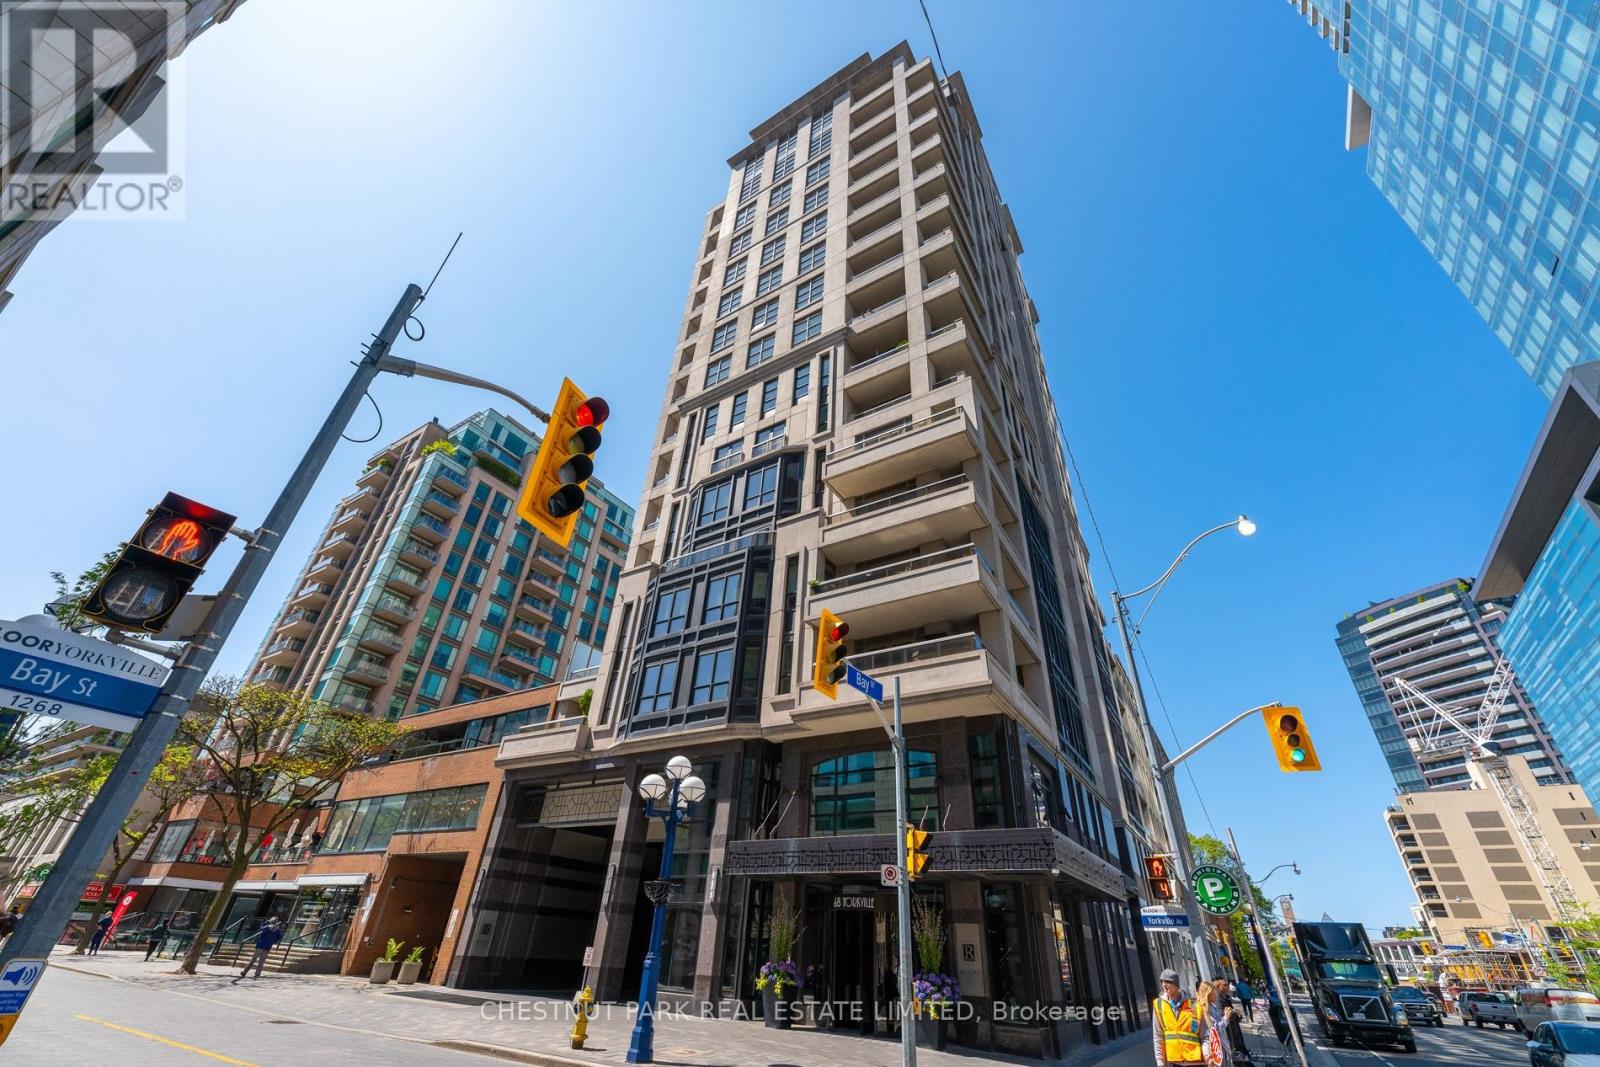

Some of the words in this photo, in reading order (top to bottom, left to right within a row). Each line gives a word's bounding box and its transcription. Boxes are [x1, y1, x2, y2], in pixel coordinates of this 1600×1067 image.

[10, 657, 71, 694] Bay
[72, 677, 98, 698] St
[856, 671, 870, 694] Bay
[10, 694, 63, 716] 1268
[1191, 866, 1233, 887] MUNICIPAL
[1202, 877, 1224, 898] P
[833, 896, 842, 908] 68
[842, 896, 875, 909] YORKVILLE
[1195, 891, 1239, 913] PARKING
[1147, 916, 1174, 926] Yorkville
